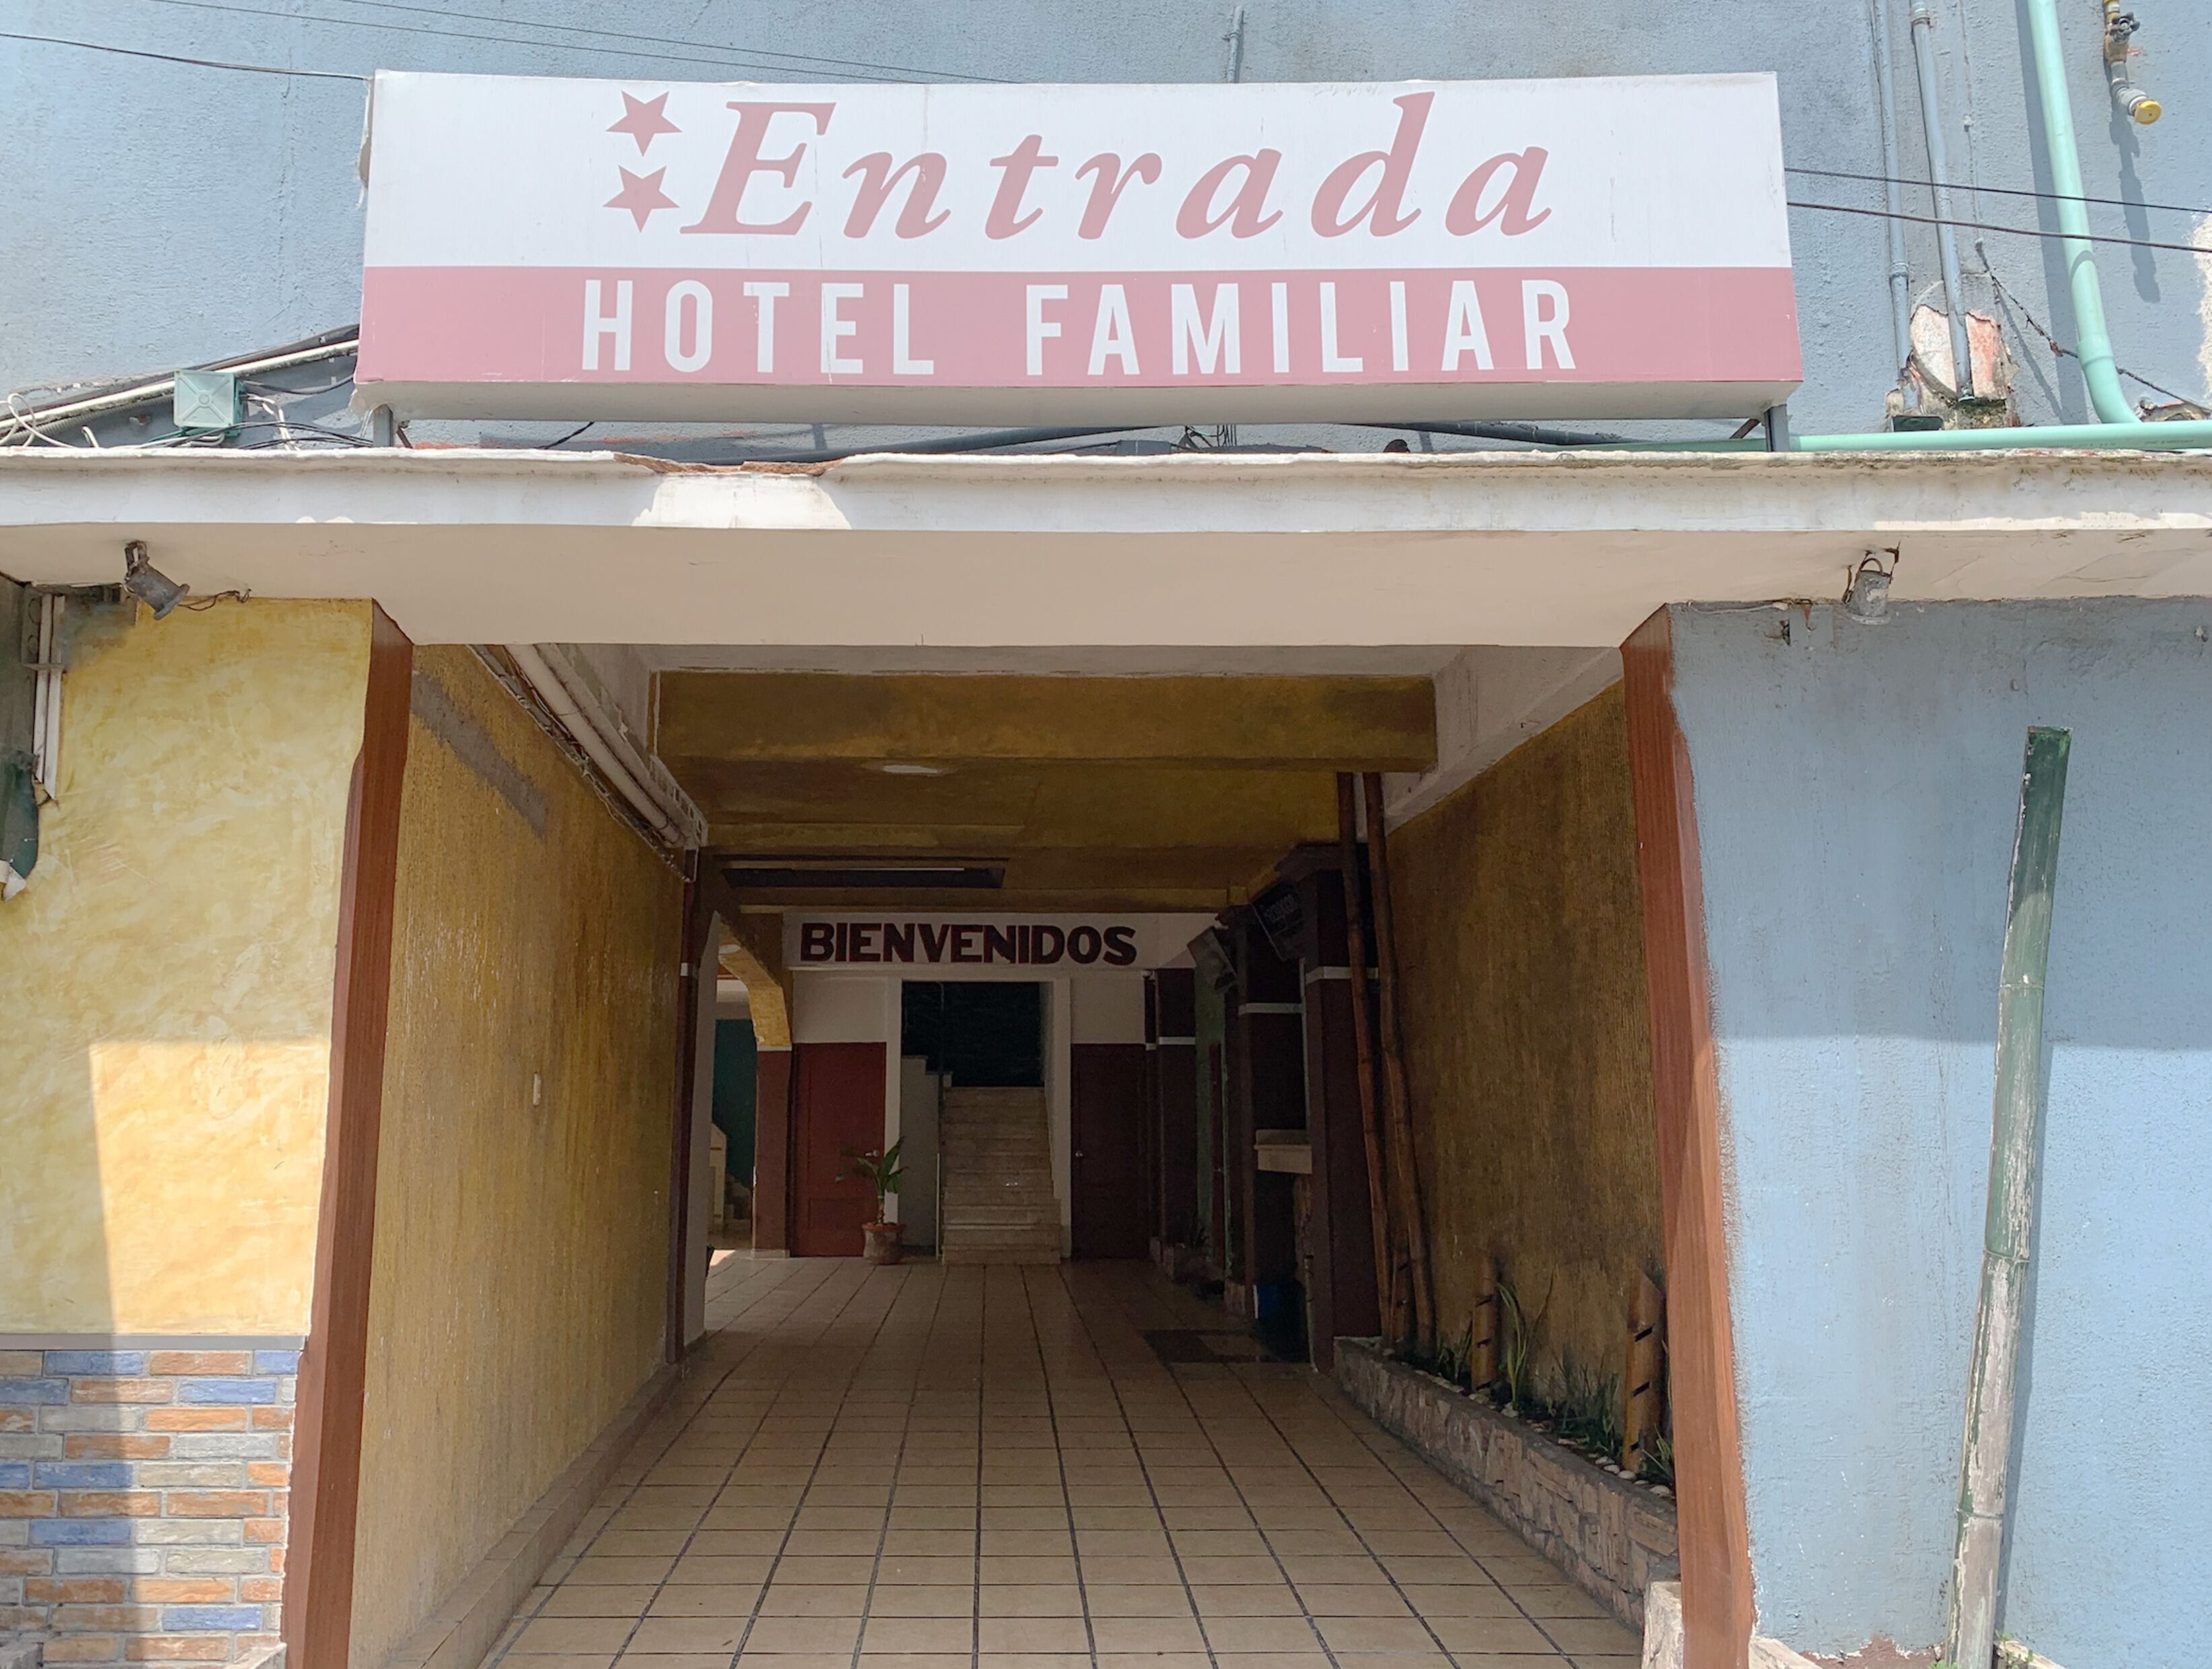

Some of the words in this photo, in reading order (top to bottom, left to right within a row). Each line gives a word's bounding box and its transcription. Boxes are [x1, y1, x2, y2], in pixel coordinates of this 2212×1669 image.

[681, 92, 1551, 240] Entrada
[581, 279, 935, 377] HOTEL
[1025, 279, 1576, 377] FAMILIAR
[800, 922, 1138, 966] BIENVENIDOS
